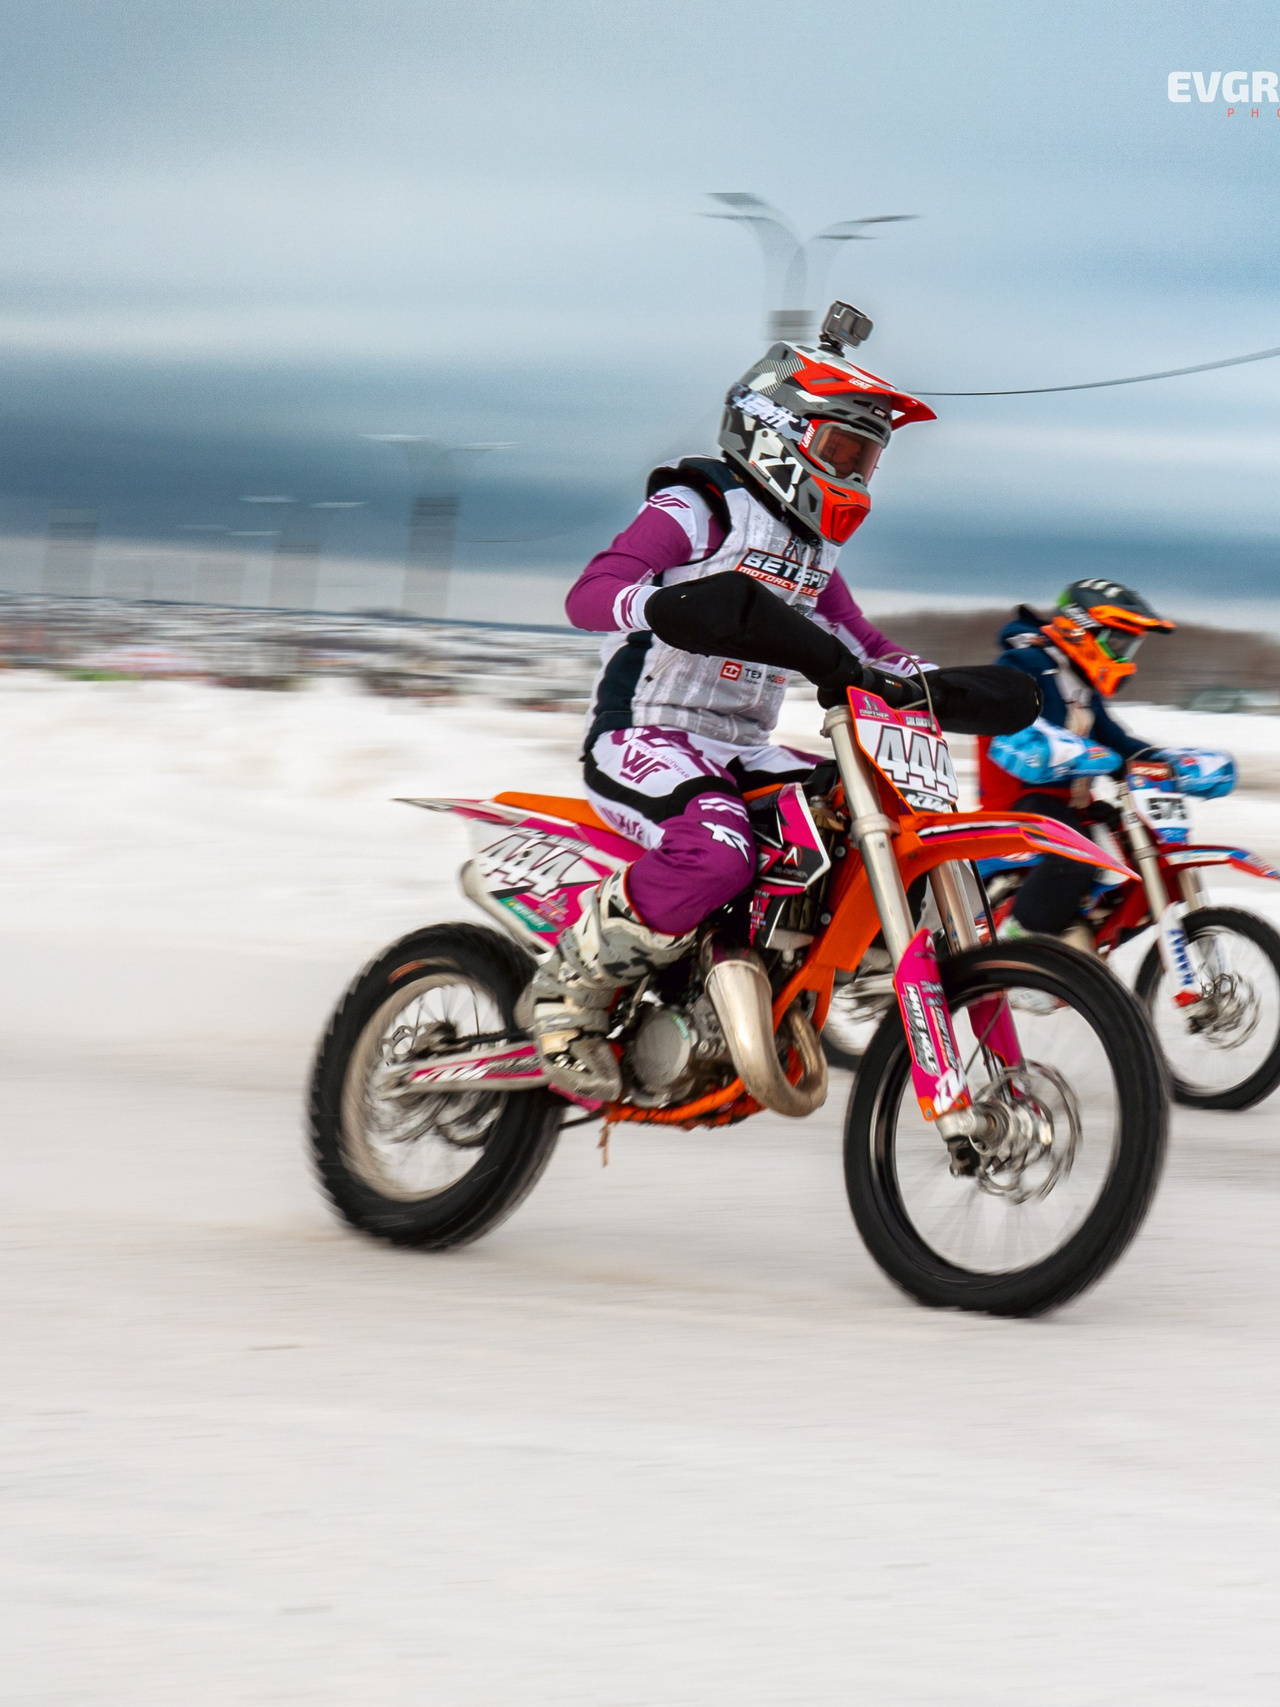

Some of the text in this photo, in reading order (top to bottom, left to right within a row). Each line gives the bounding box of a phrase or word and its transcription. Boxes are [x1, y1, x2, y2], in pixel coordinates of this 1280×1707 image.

[848, 377, 873, 391] LEATT
[801, 423, 815, 448] LEATT
[875, 725, 958, 800] 444
